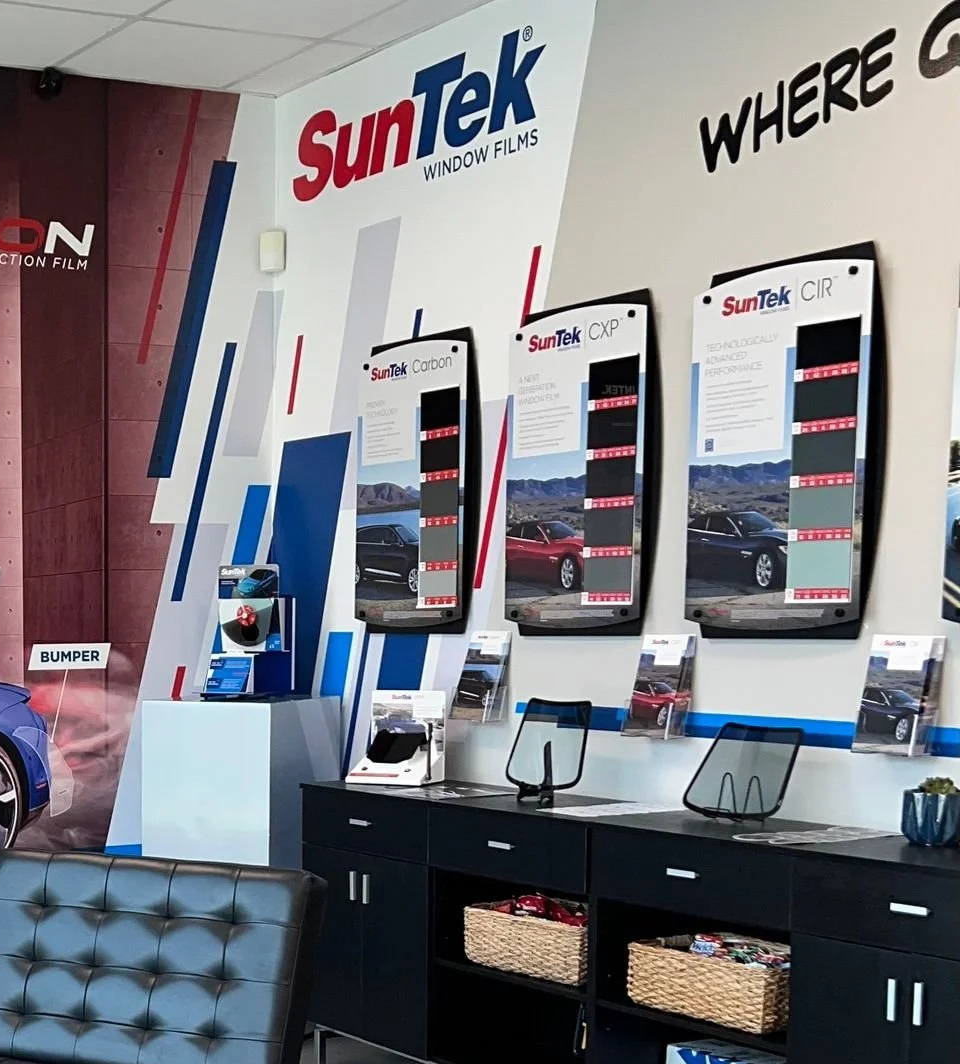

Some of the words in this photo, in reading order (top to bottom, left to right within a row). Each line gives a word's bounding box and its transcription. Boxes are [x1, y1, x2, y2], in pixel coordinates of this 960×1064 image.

[700, 28, 896, 173] WHERE
[424, 145, 488, 181] WINDOW
[494, 129, 539, 159] FILMS
[53, 257, 88, 270] FILM
[722, 285, 791, 316] SunTek
[528, 326, 581, 352] SunTek
[371, 361, 408, 381] SunTek
[412, 356, 452, 373] Carbon
[40, 651, 100, 662] BUMPER
